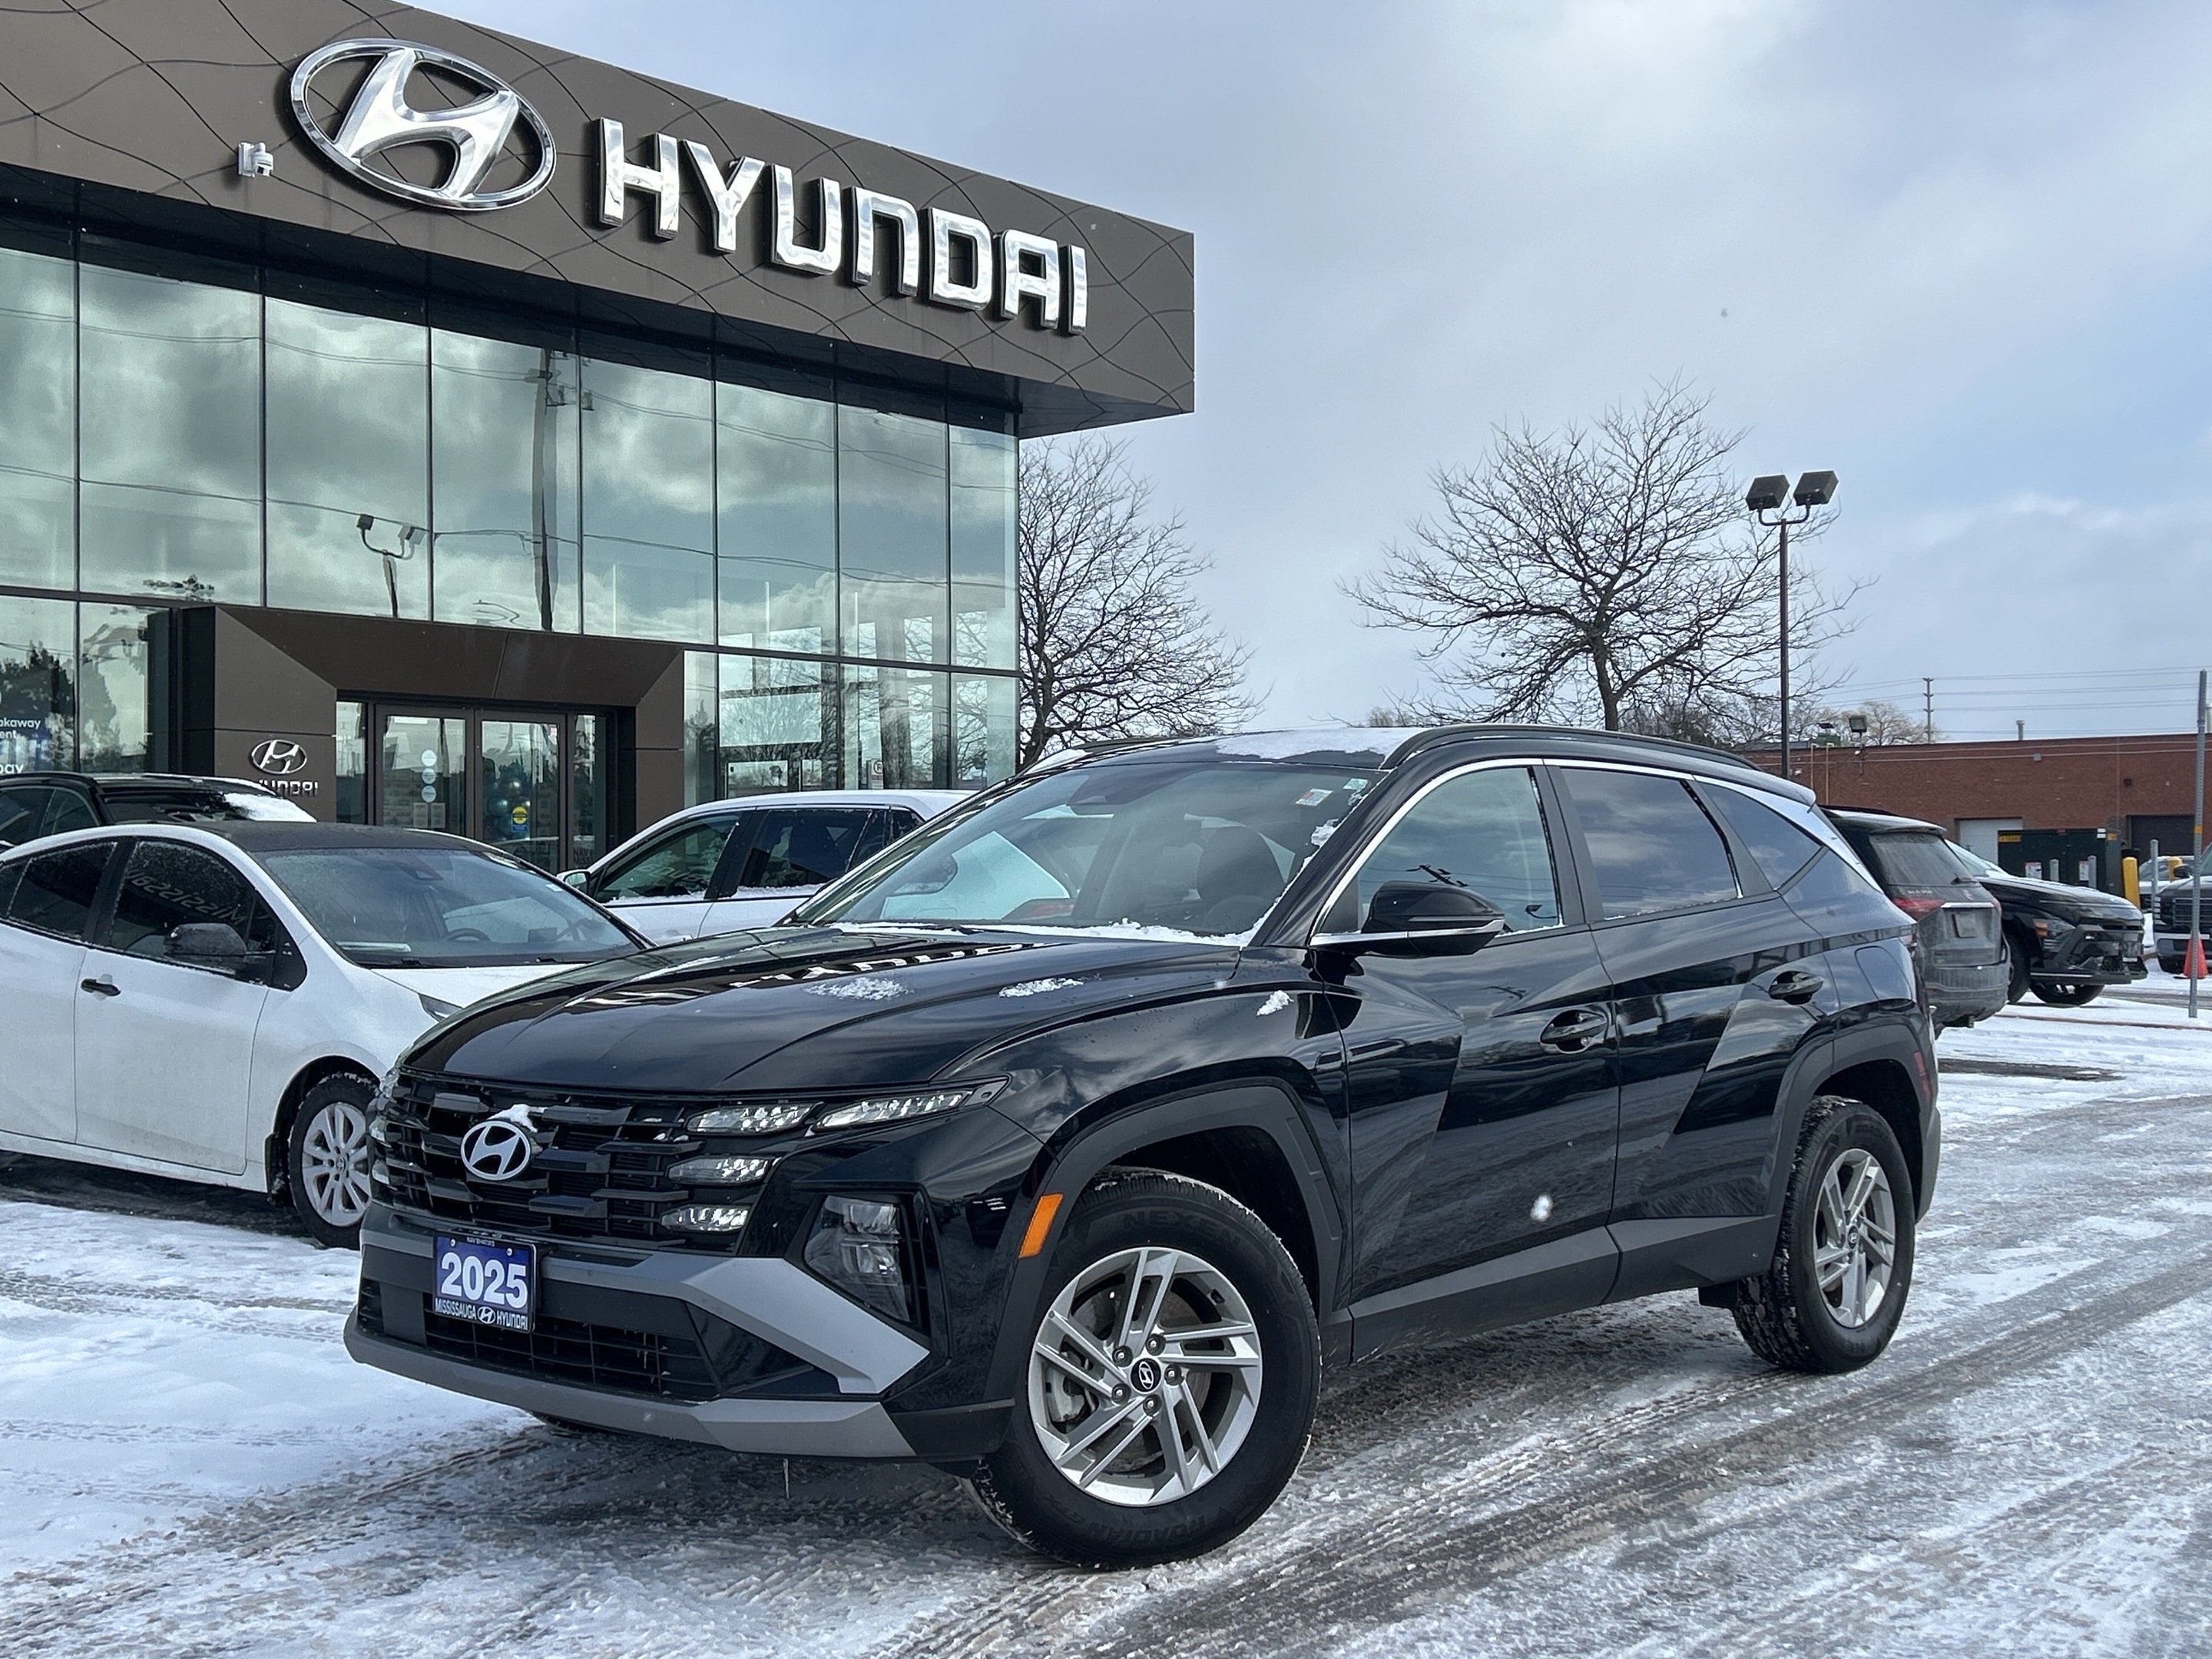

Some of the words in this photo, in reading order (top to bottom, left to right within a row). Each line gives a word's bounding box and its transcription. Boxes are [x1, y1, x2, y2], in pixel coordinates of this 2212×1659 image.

[594, 117, 1088, 336] HYUNDAI
[259, 779, 318, 796] UNDAI
[441, 1252, 528, 1309] 2025
[435, 1297, 477, 1320] MISSISSAUGA
[496, 1310, 528, 1330] HYUNDAI
